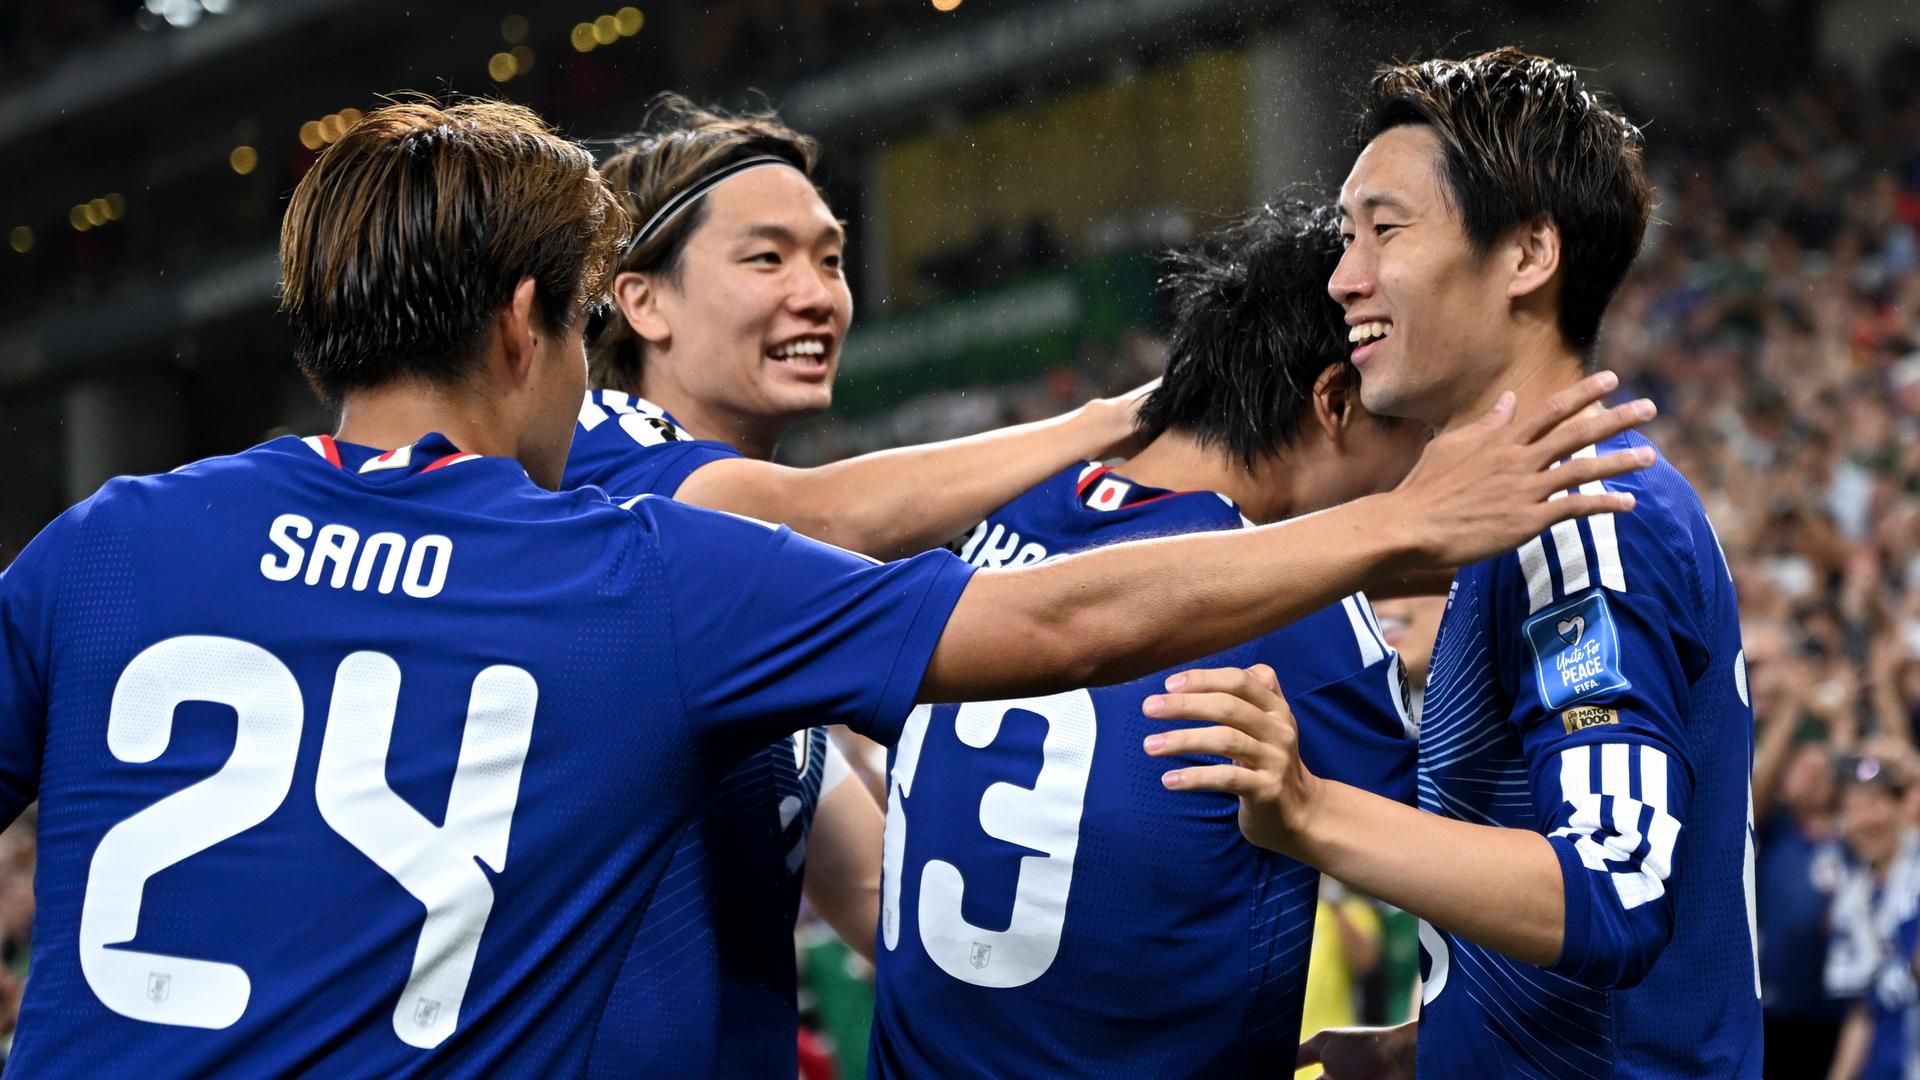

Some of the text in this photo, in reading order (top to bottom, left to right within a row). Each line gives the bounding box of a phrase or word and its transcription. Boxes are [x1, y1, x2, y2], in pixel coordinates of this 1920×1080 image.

[260, 513, 453, 598] SANO
[1557, 639, 1600, 670] Unite For
[1561, 656, 1604, 687] PEACE
[1574, 680, 1598, 694] FIFA
[1579, 707, 1609, 717] MATCH
[1580, 714, 1611, 727] 1000
[79, 635, 539, 1049] 24
[882, 688, 1097, 988] 13
